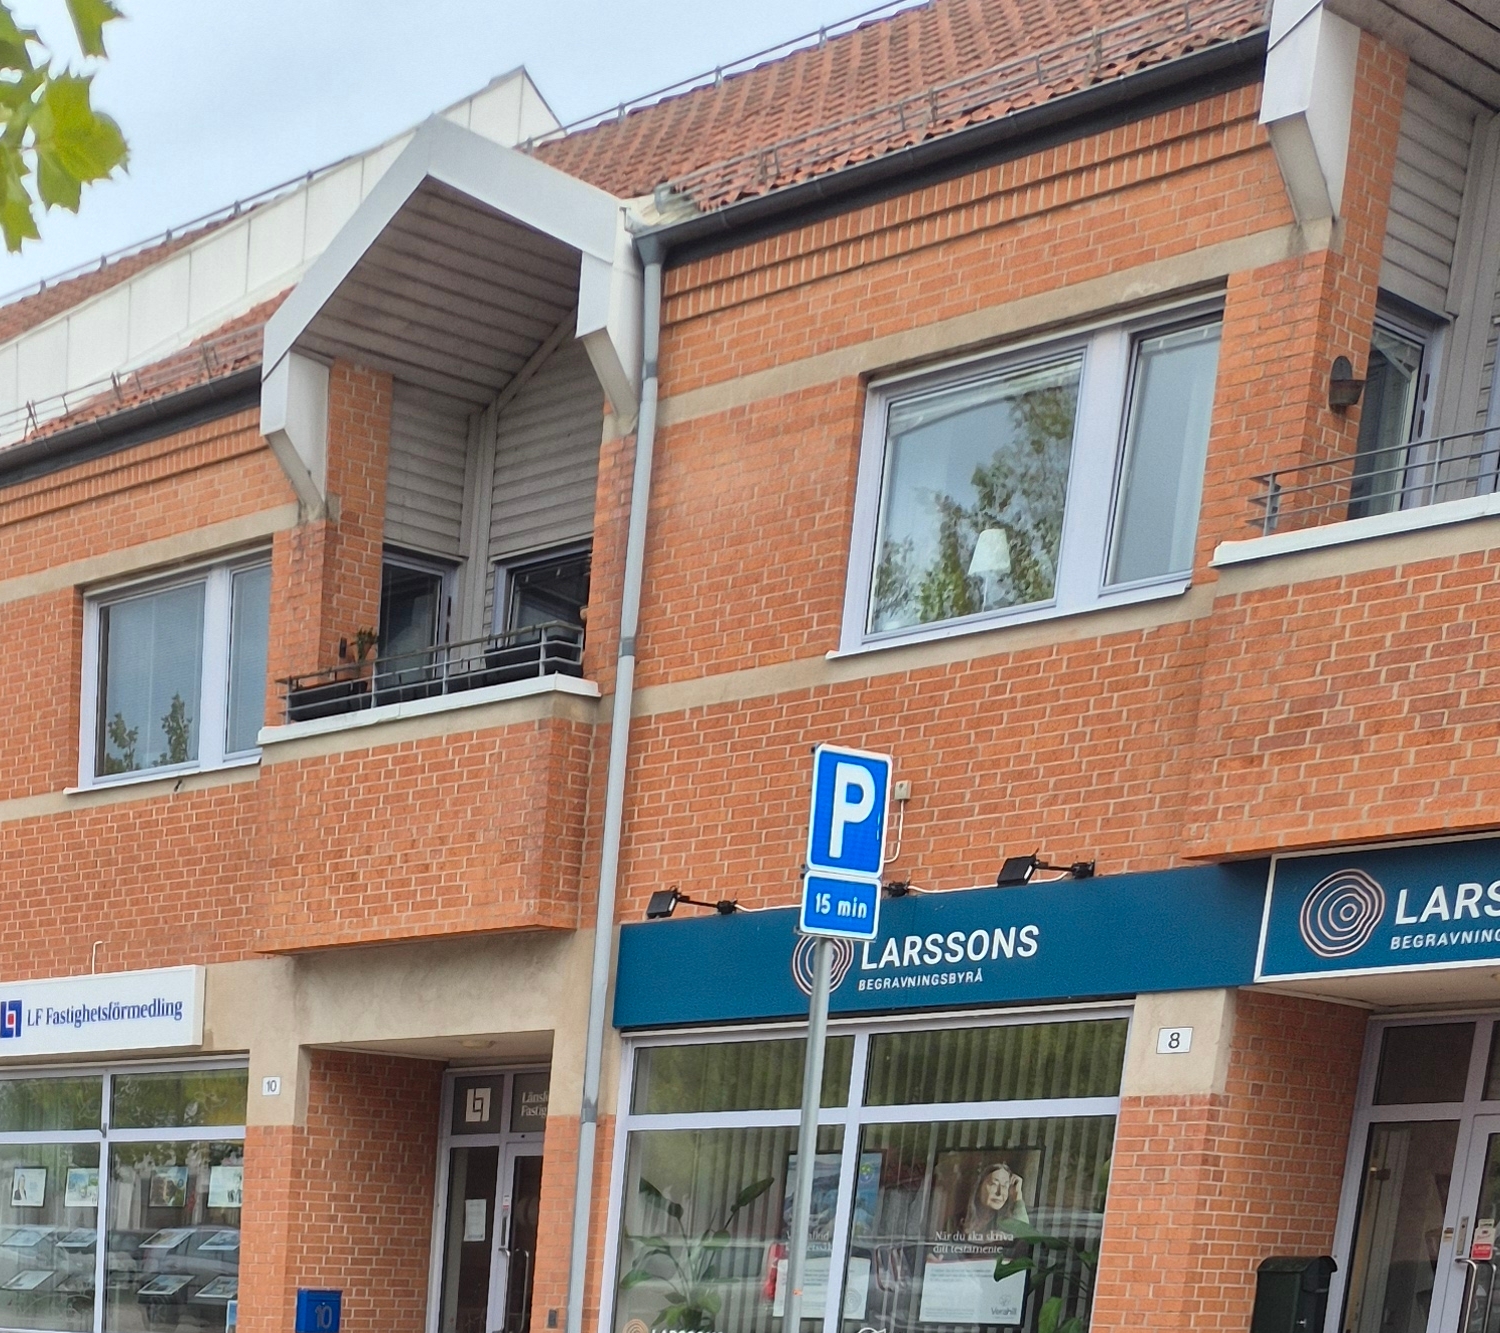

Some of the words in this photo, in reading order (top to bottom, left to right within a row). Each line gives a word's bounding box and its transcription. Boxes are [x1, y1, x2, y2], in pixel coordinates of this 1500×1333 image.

[828, 761, 876, 859] P
[815, 893, 831, 915] 15
[837, 897, 868, 919] min
[860, 924, 1040, 970] LARSSONS
[858, 968, 983, 991] BEGRAVNINGSBYRÅ
[27, 1007, 43, 1027] LF
[45, 997, 183, 1029] Fastighetsförmedling
[1168, 1032, 1181, 1049] 8
[266, 1079, 278, 1093] 10
[953, 1231, 966, 1241] du
[968, 1230, 984, 1241] ska
[950, 1244, 1004, 1254] testamente
[315, 1304, 332, 1329] 10
